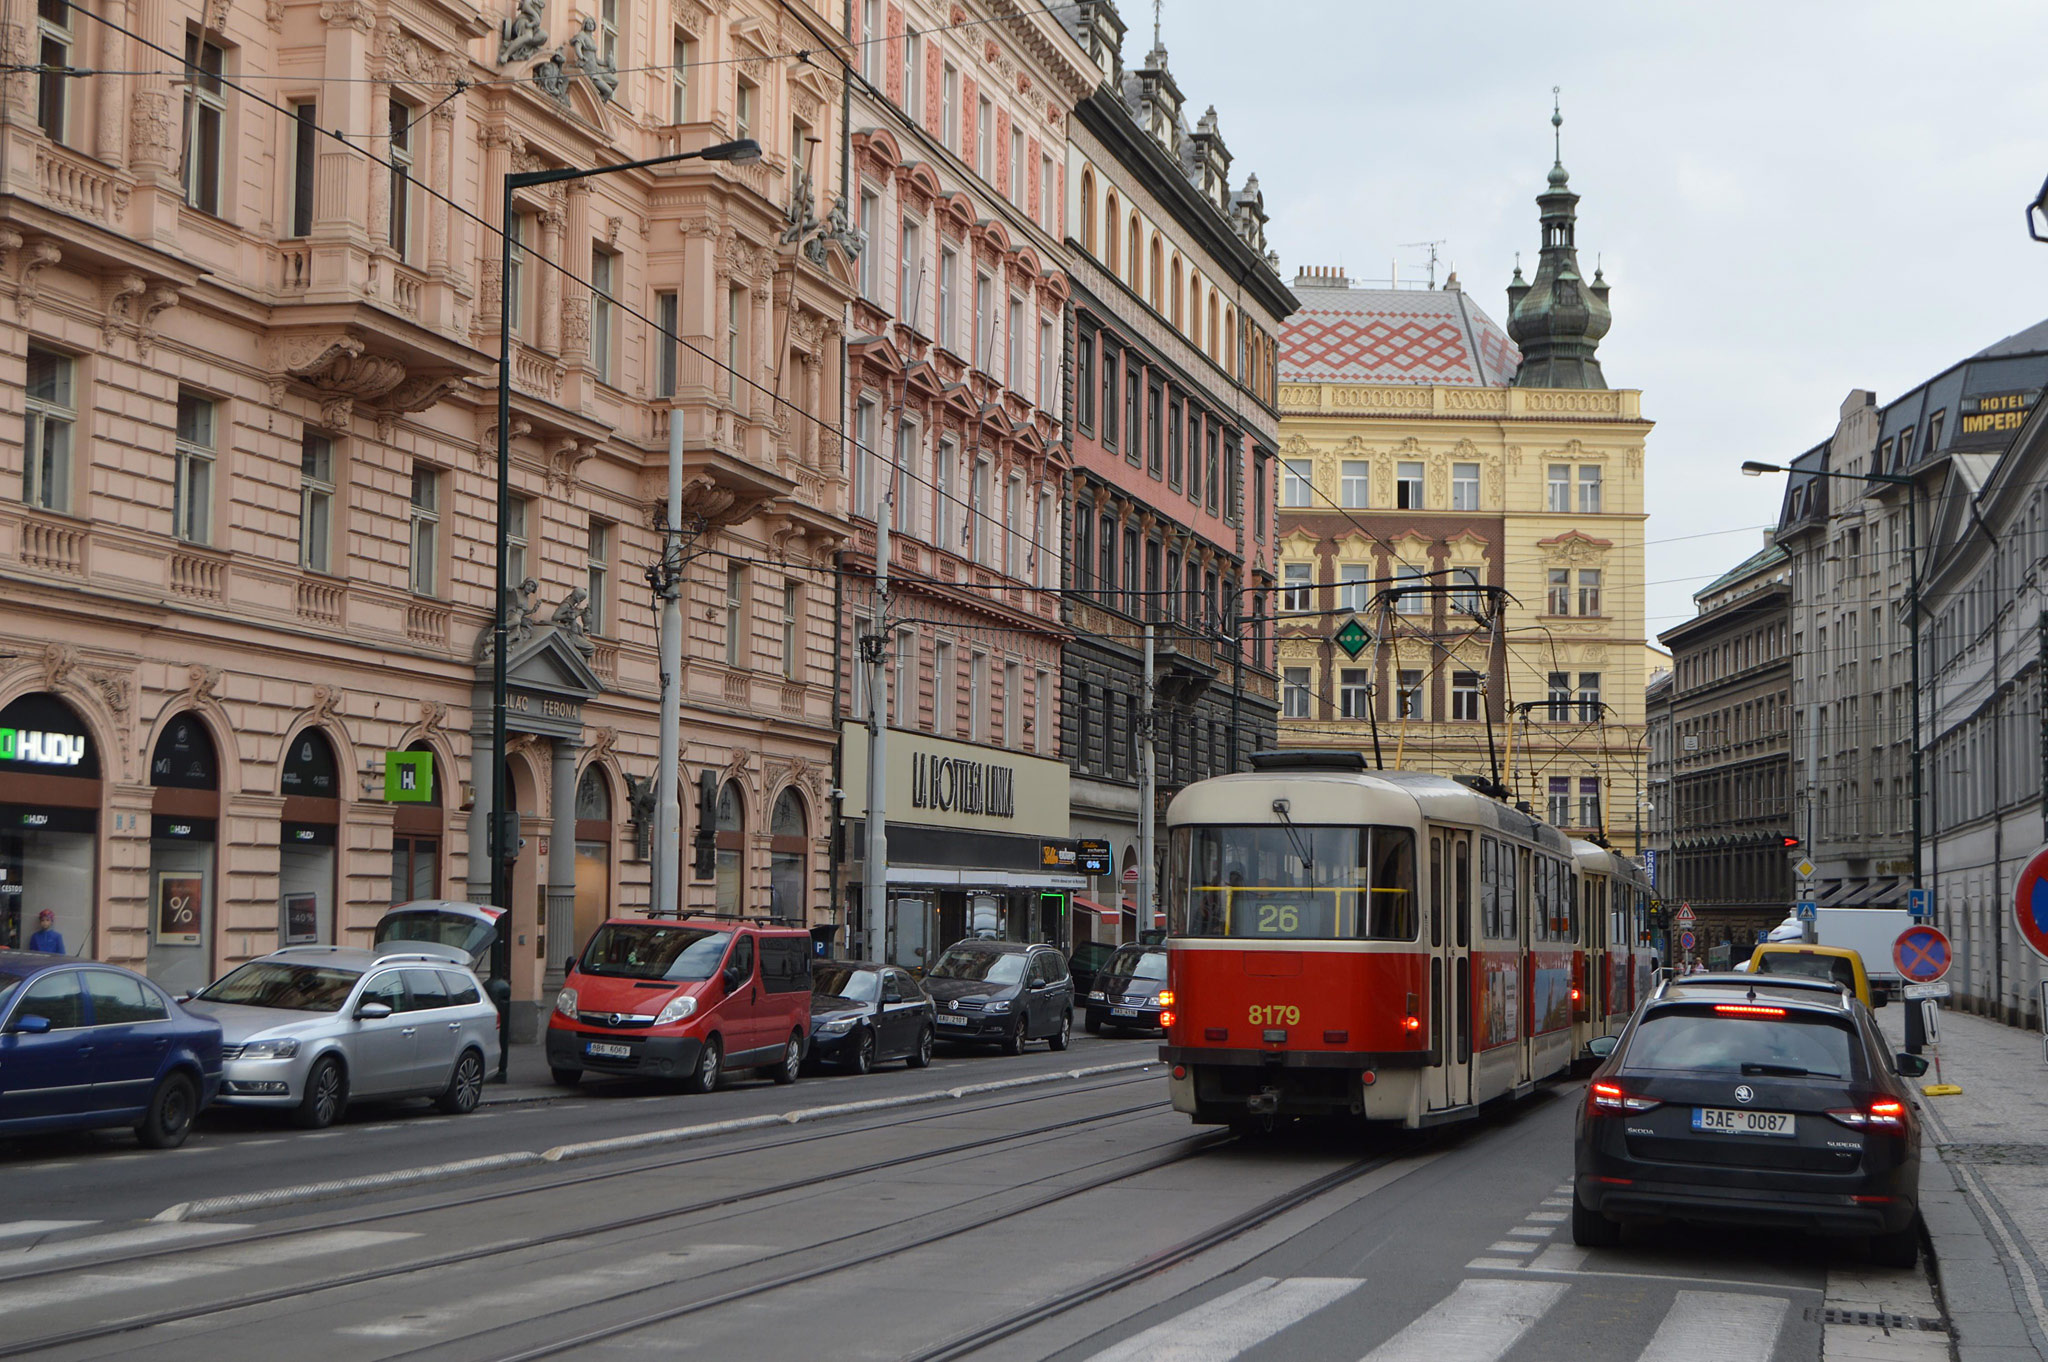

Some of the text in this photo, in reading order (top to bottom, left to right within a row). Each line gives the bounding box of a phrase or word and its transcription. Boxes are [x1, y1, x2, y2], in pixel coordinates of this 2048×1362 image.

[1981, 395, 2024, 411] HOTEL
[1963, 410, 2028, 433] IMPERI
[506, 693, 577, 718] ALÁC FERONA
[17, 729, 85, 766] HUDY
[913, 752, 1014, 819] LA BOTTEGA LINKA
[170, 896, 193, 923] %
[1258, 904, 1299, 933] 26
[816, 941, 824, 953] P
[1248, 1004, 1300, 1026] 8179
[1705, 1110, 1787, 1131] 5AE 0087
[1826, 1140, 1861, 1149] SUPERB
